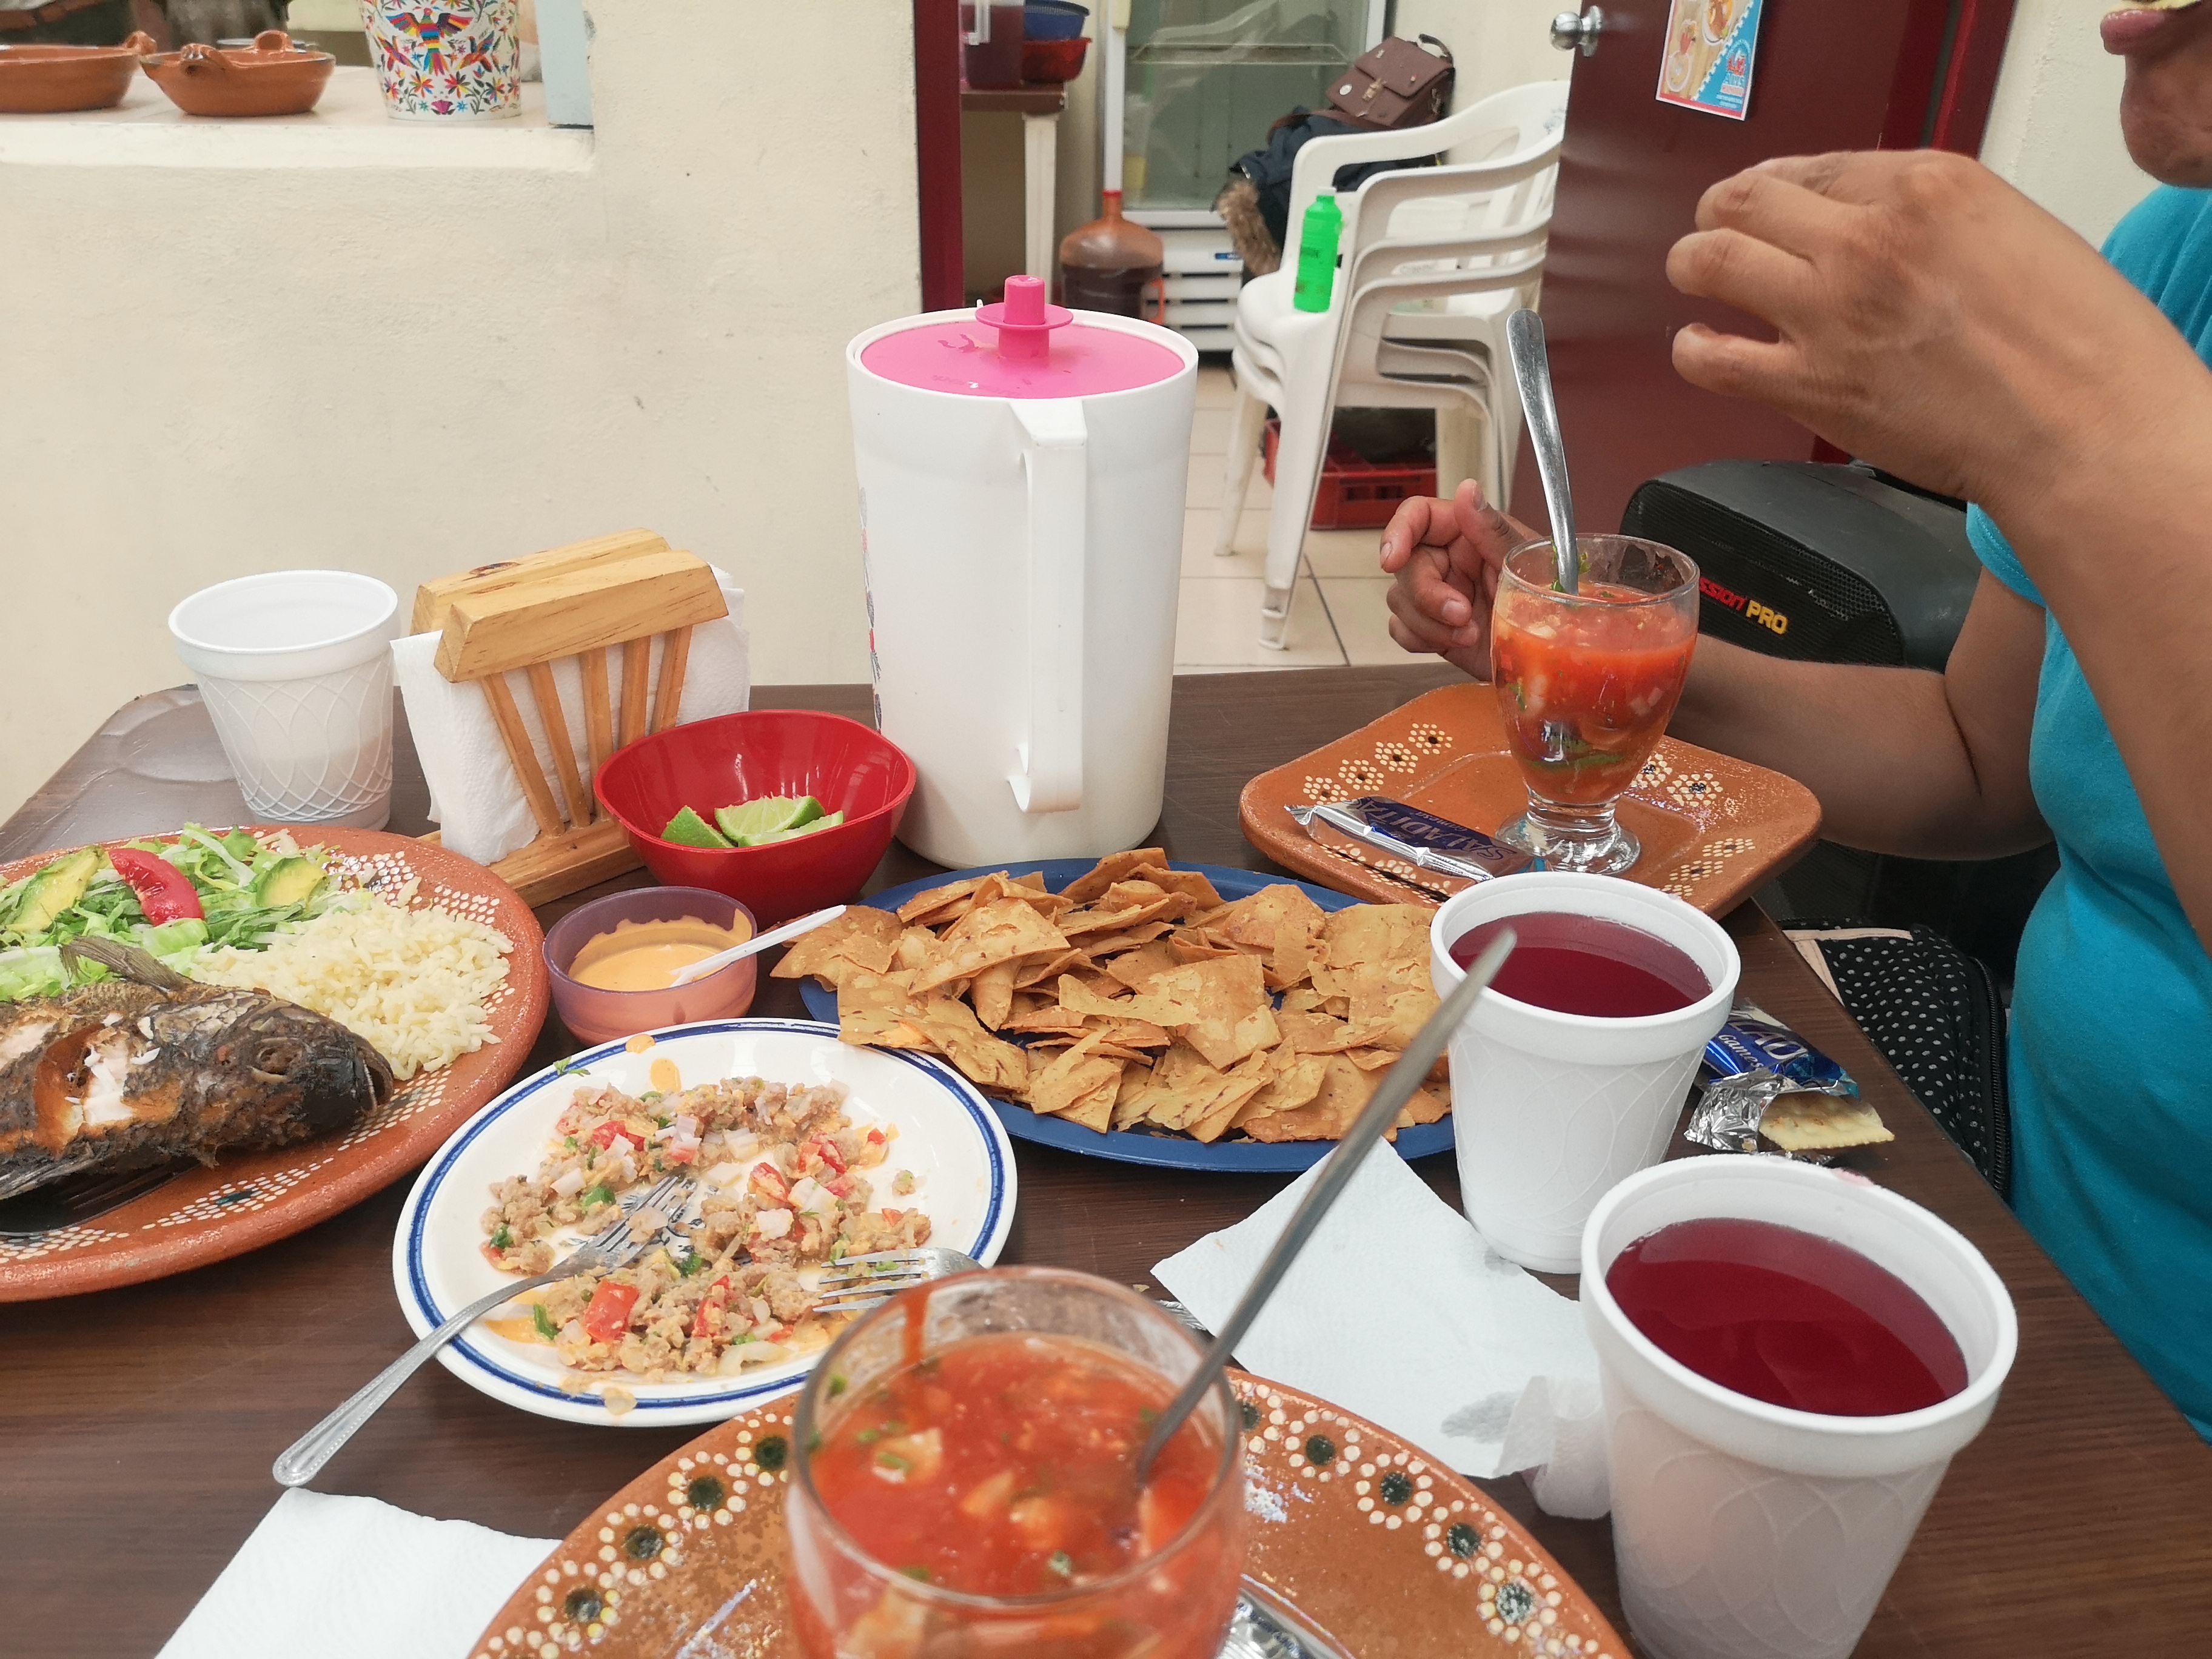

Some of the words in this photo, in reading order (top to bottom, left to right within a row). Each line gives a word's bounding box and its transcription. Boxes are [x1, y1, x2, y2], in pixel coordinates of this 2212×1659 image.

[1699, 577, 1746, 611] ssion
[1745, 599, 1788, 635] PRO
[1718, 1034, 1766, 1068] Games
